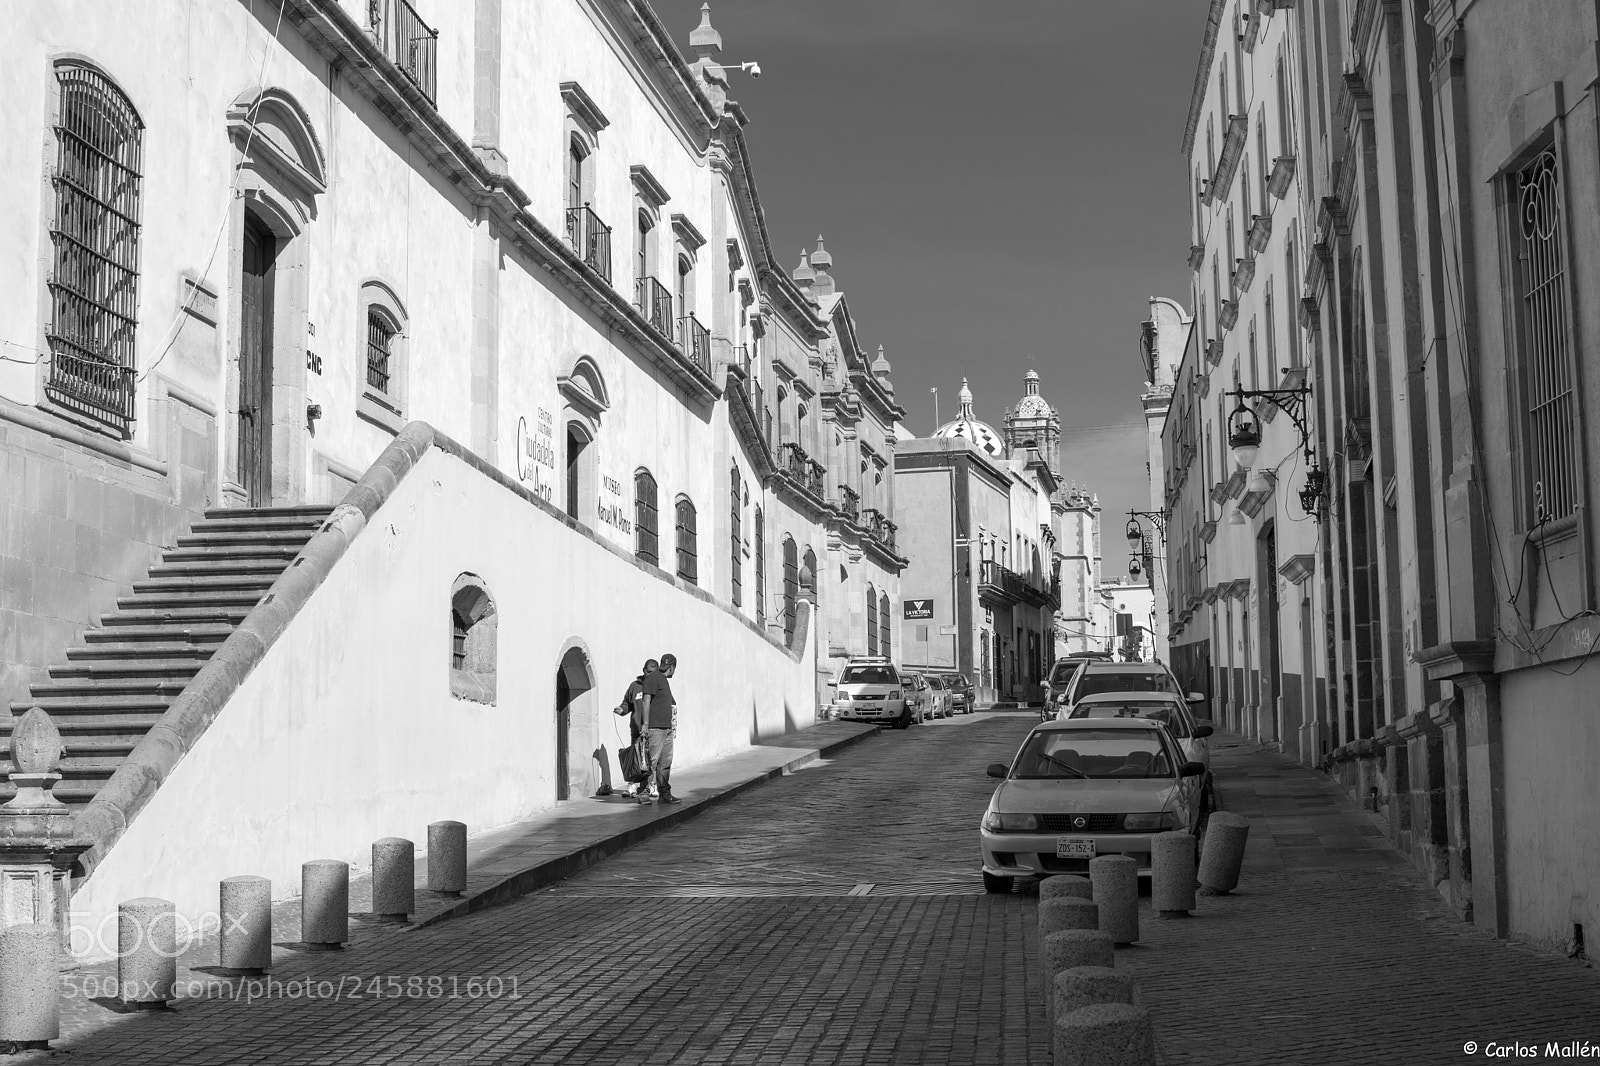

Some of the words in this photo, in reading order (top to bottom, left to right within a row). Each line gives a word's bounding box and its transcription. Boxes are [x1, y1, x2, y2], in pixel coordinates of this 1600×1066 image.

[306, 349, 322, 376] CNC
[517, 415, 554, 481] Ciudadela
[534, 465, 552, 502] Arte
[603, 473, 621, 496] MUSEO
[618, 507, 631, 536] Ponce
[1058, 843, 1095, 853] ZDS-152-A
